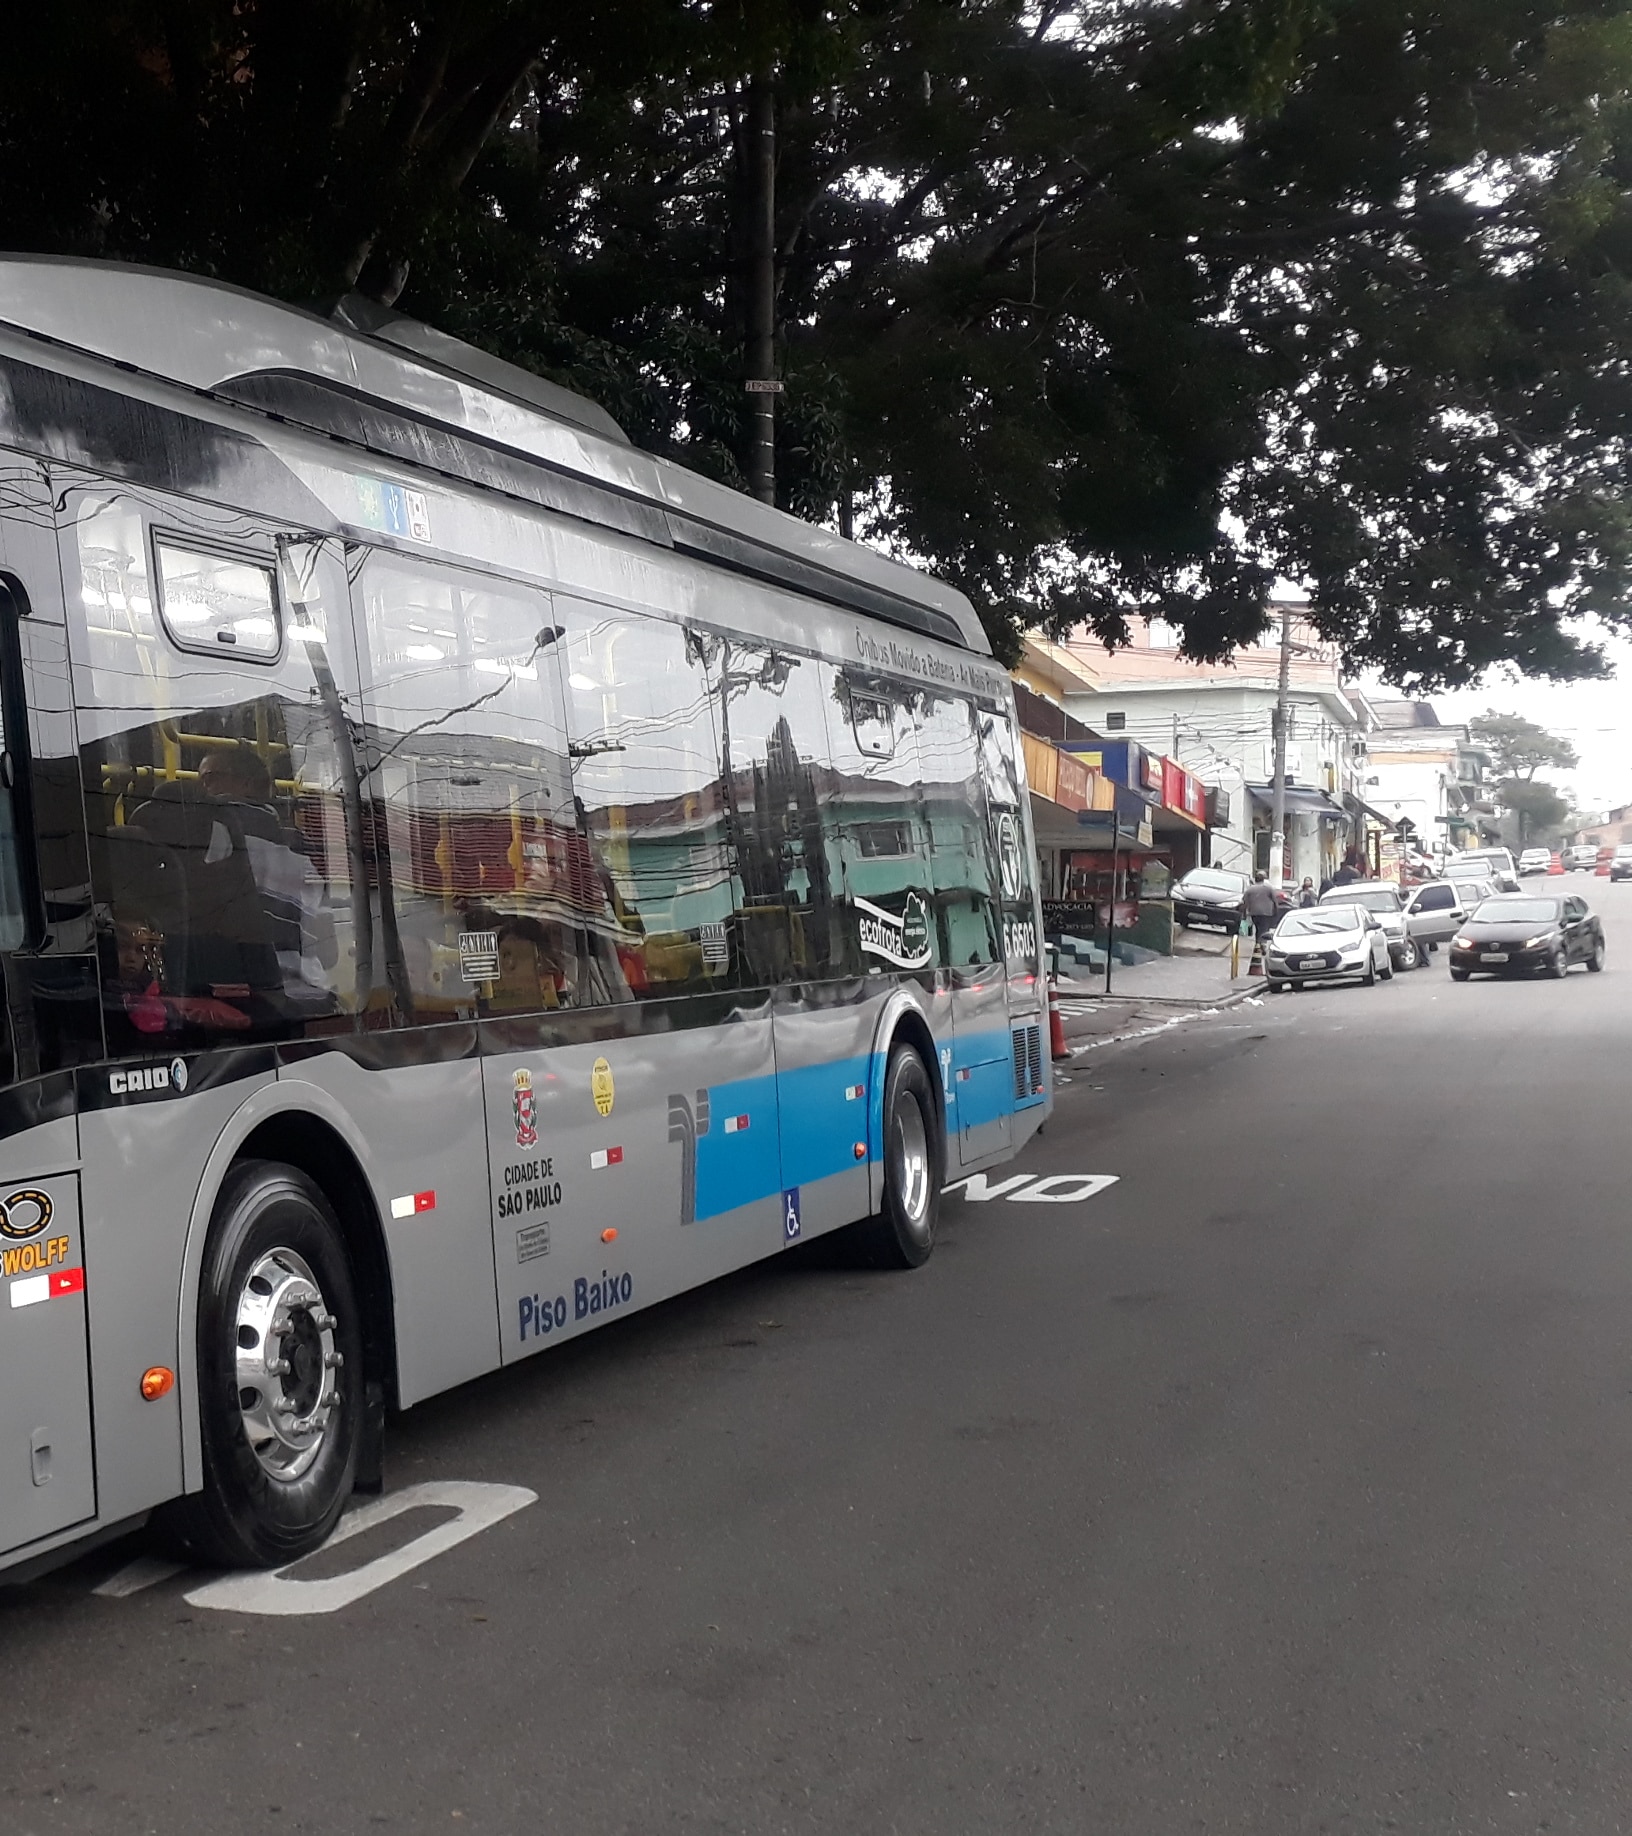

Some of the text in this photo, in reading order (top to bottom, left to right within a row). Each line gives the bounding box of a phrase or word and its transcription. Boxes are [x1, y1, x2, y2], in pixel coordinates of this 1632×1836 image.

[855, 626, 890, 665] Ônibus
[889, 641, 921, 674] Movido
[921, 658, 928, 676] a
[859, 916, 902, 956] ecofrota
[1003, 921, 1036, 959] 6 6503
[109, 1066, 169, 1095] CAIO
[504, 1157, 554, 1186] CIDADE DE
[498, 1182, 562, 1218] SÃO PAULO
[519, 1269, 633, 1341] Piso Baixo
